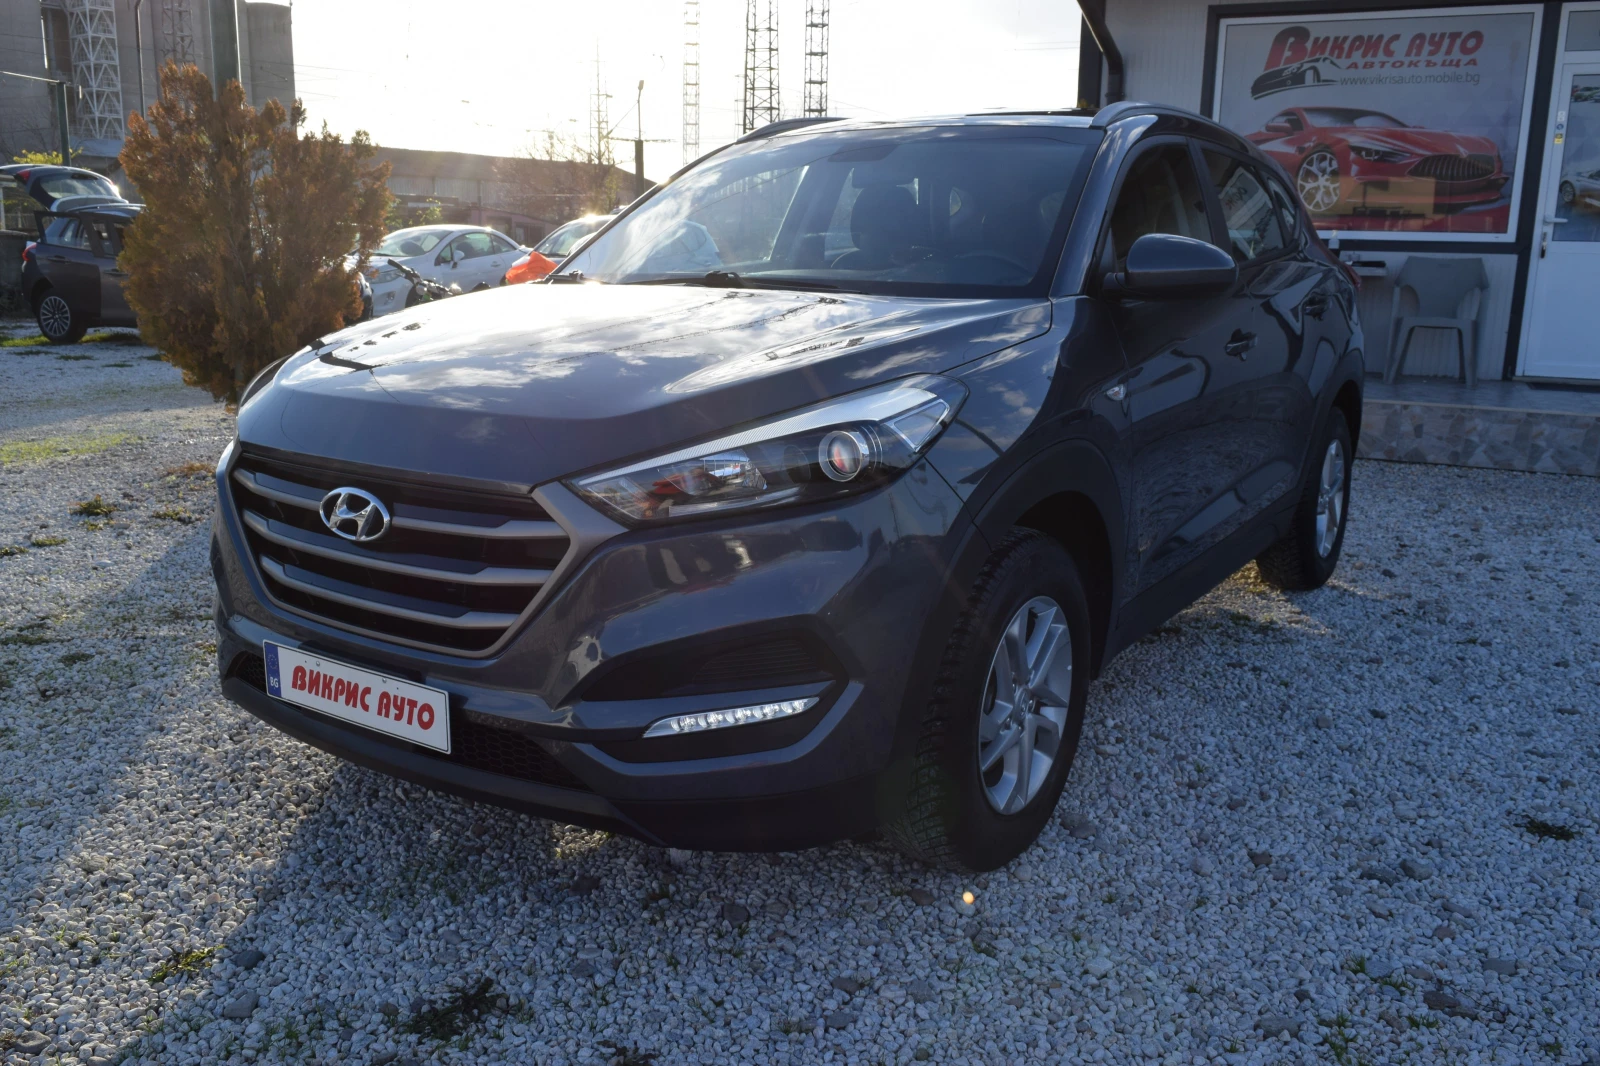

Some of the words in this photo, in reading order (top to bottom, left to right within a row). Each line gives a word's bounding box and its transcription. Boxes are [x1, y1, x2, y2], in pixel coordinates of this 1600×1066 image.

[1265, 27, 1401, 72] ВИКРИС
[1406, 31, 1484, 58] АУТО
[1346, 59, 1478, 70] АВТОКЪЩА
[1340, 72, 1480, 86] www.vikrisauto.mobile.bg
[270, 677, 279, 688] BG
[292, 665, 371, 712] ВИКРИС
[377, 691, 435, 730] АУТО
